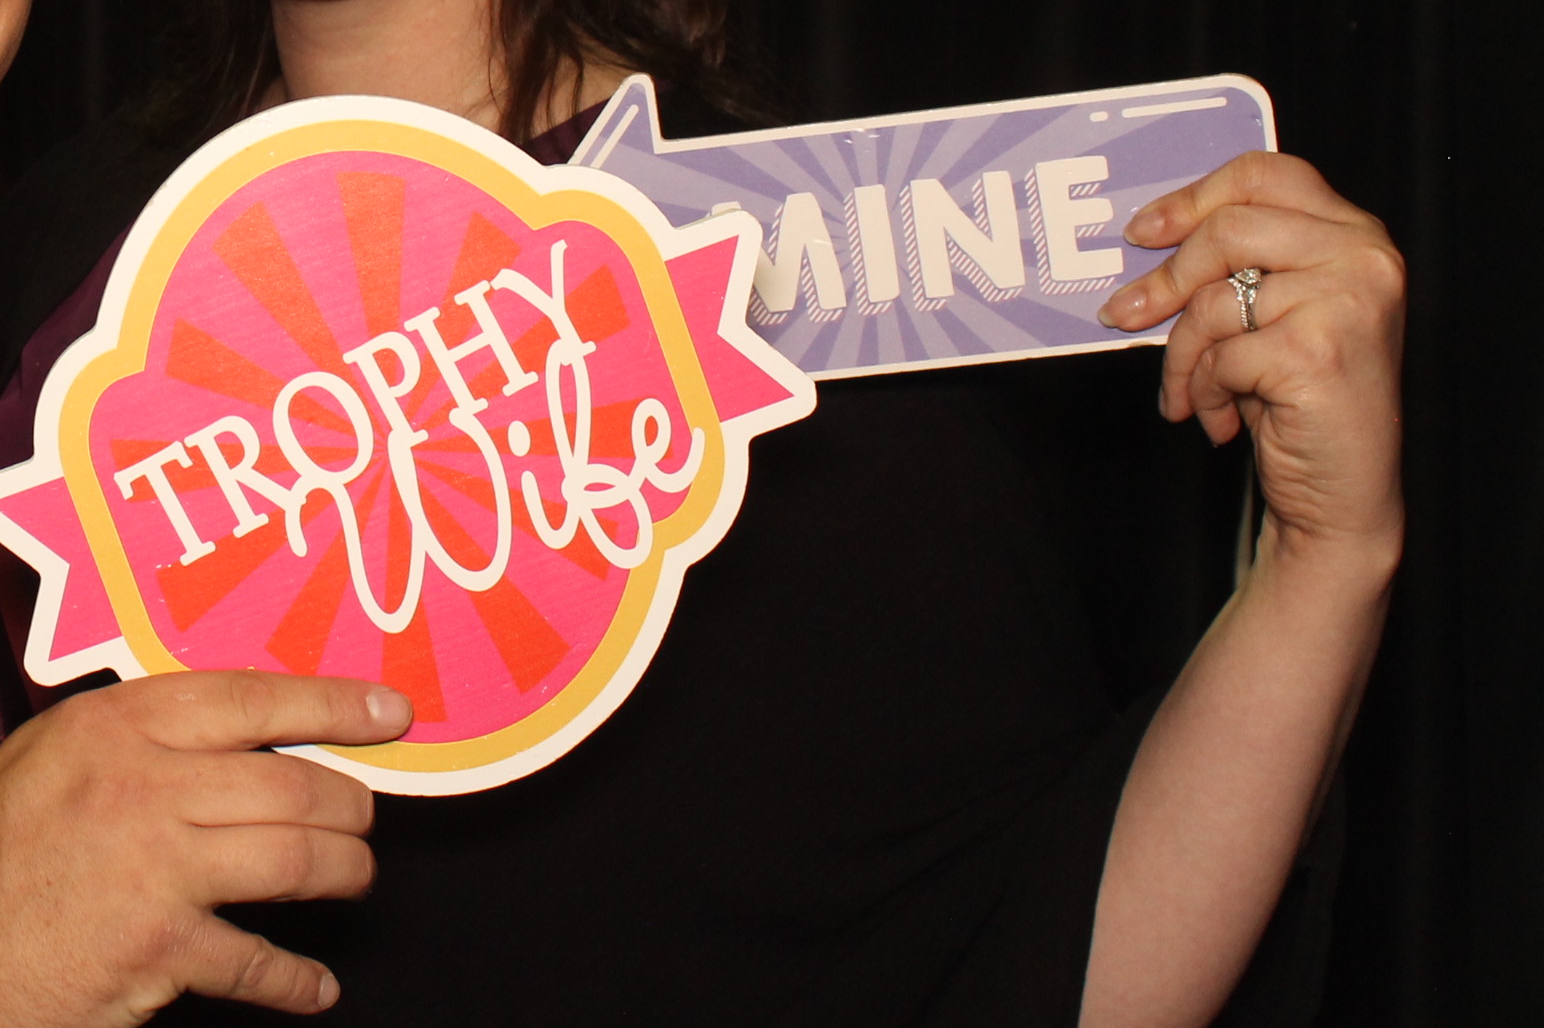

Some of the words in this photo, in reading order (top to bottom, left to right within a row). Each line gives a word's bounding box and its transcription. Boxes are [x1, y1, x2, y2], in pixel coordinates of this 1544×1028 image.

[712, 155, 1124, 325] MINE
[114, 239, 596, 566] TROPHY
[285, 338, 706, 634] Wife
